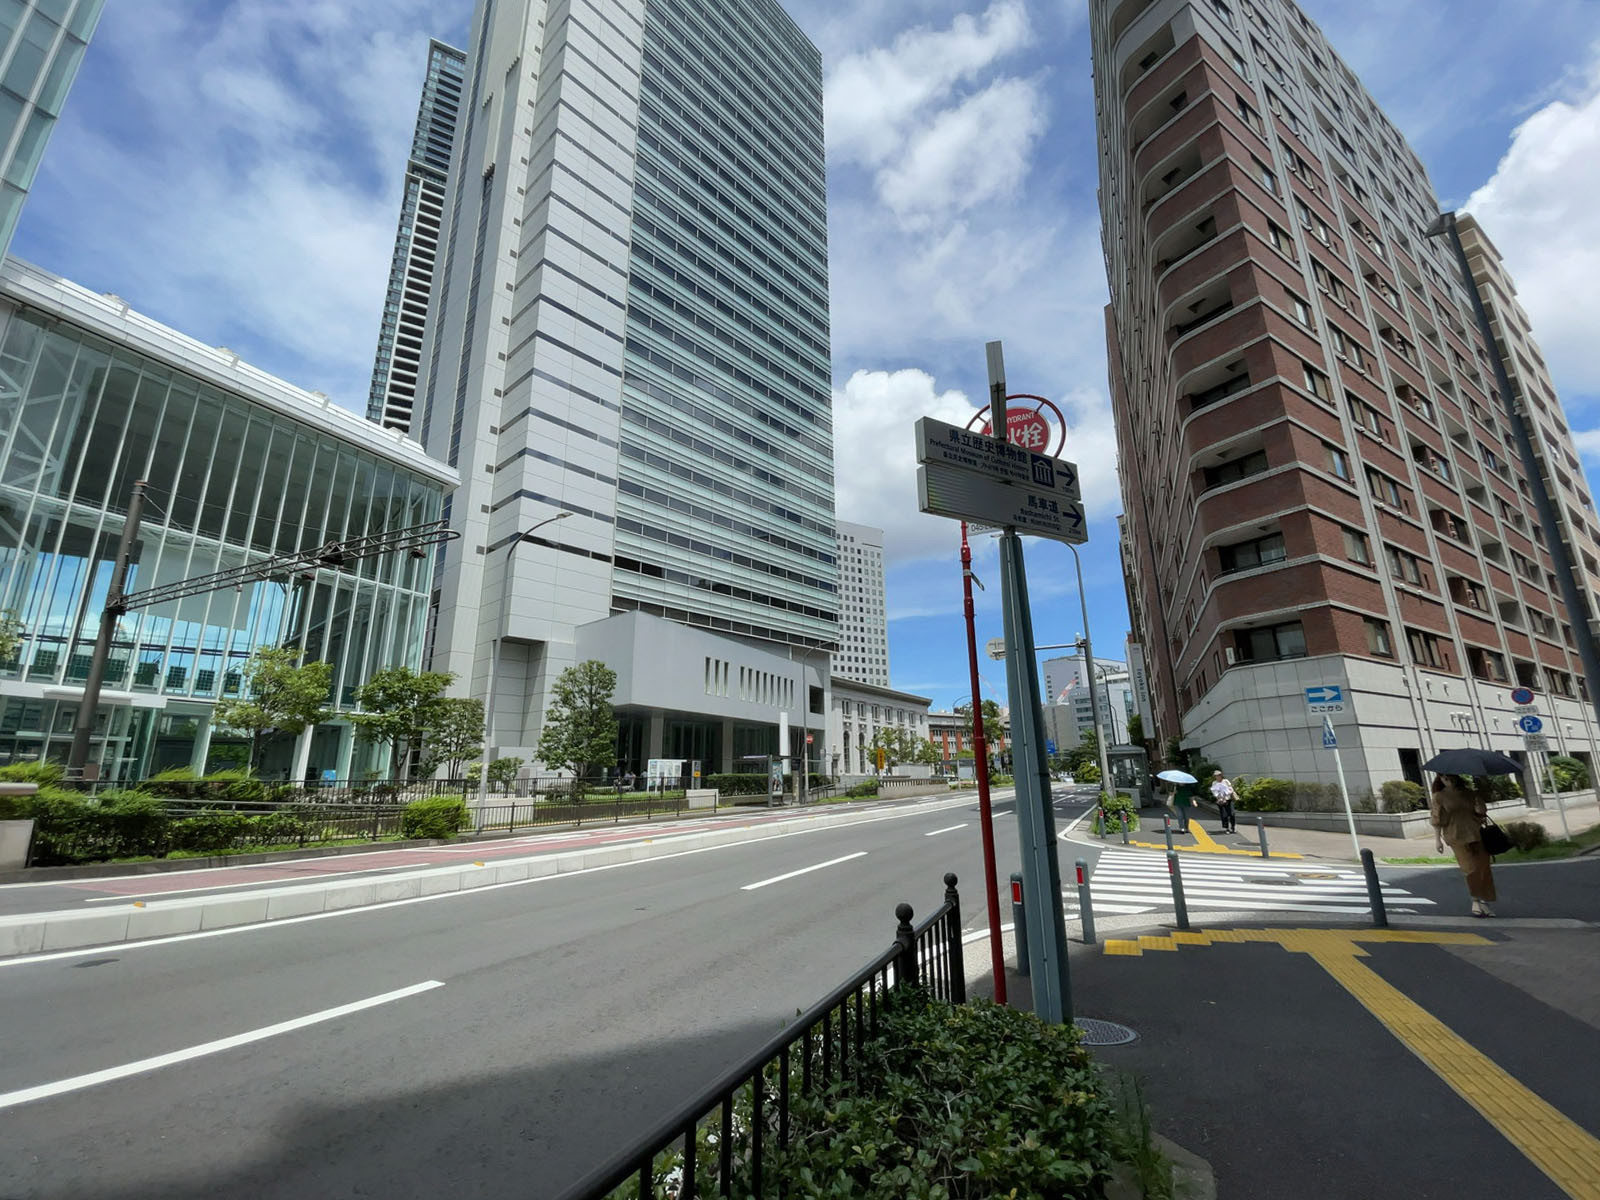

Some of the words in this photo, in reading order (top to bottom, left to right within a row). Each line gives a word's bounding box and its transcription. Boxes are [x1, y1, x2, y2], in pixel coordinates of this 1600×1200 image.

[948, 428, 1028, 464] 県立歴史博物館
[1028, 496, 1059, 514] 馬車道
[1311, 704, 1343, 713] ここから
